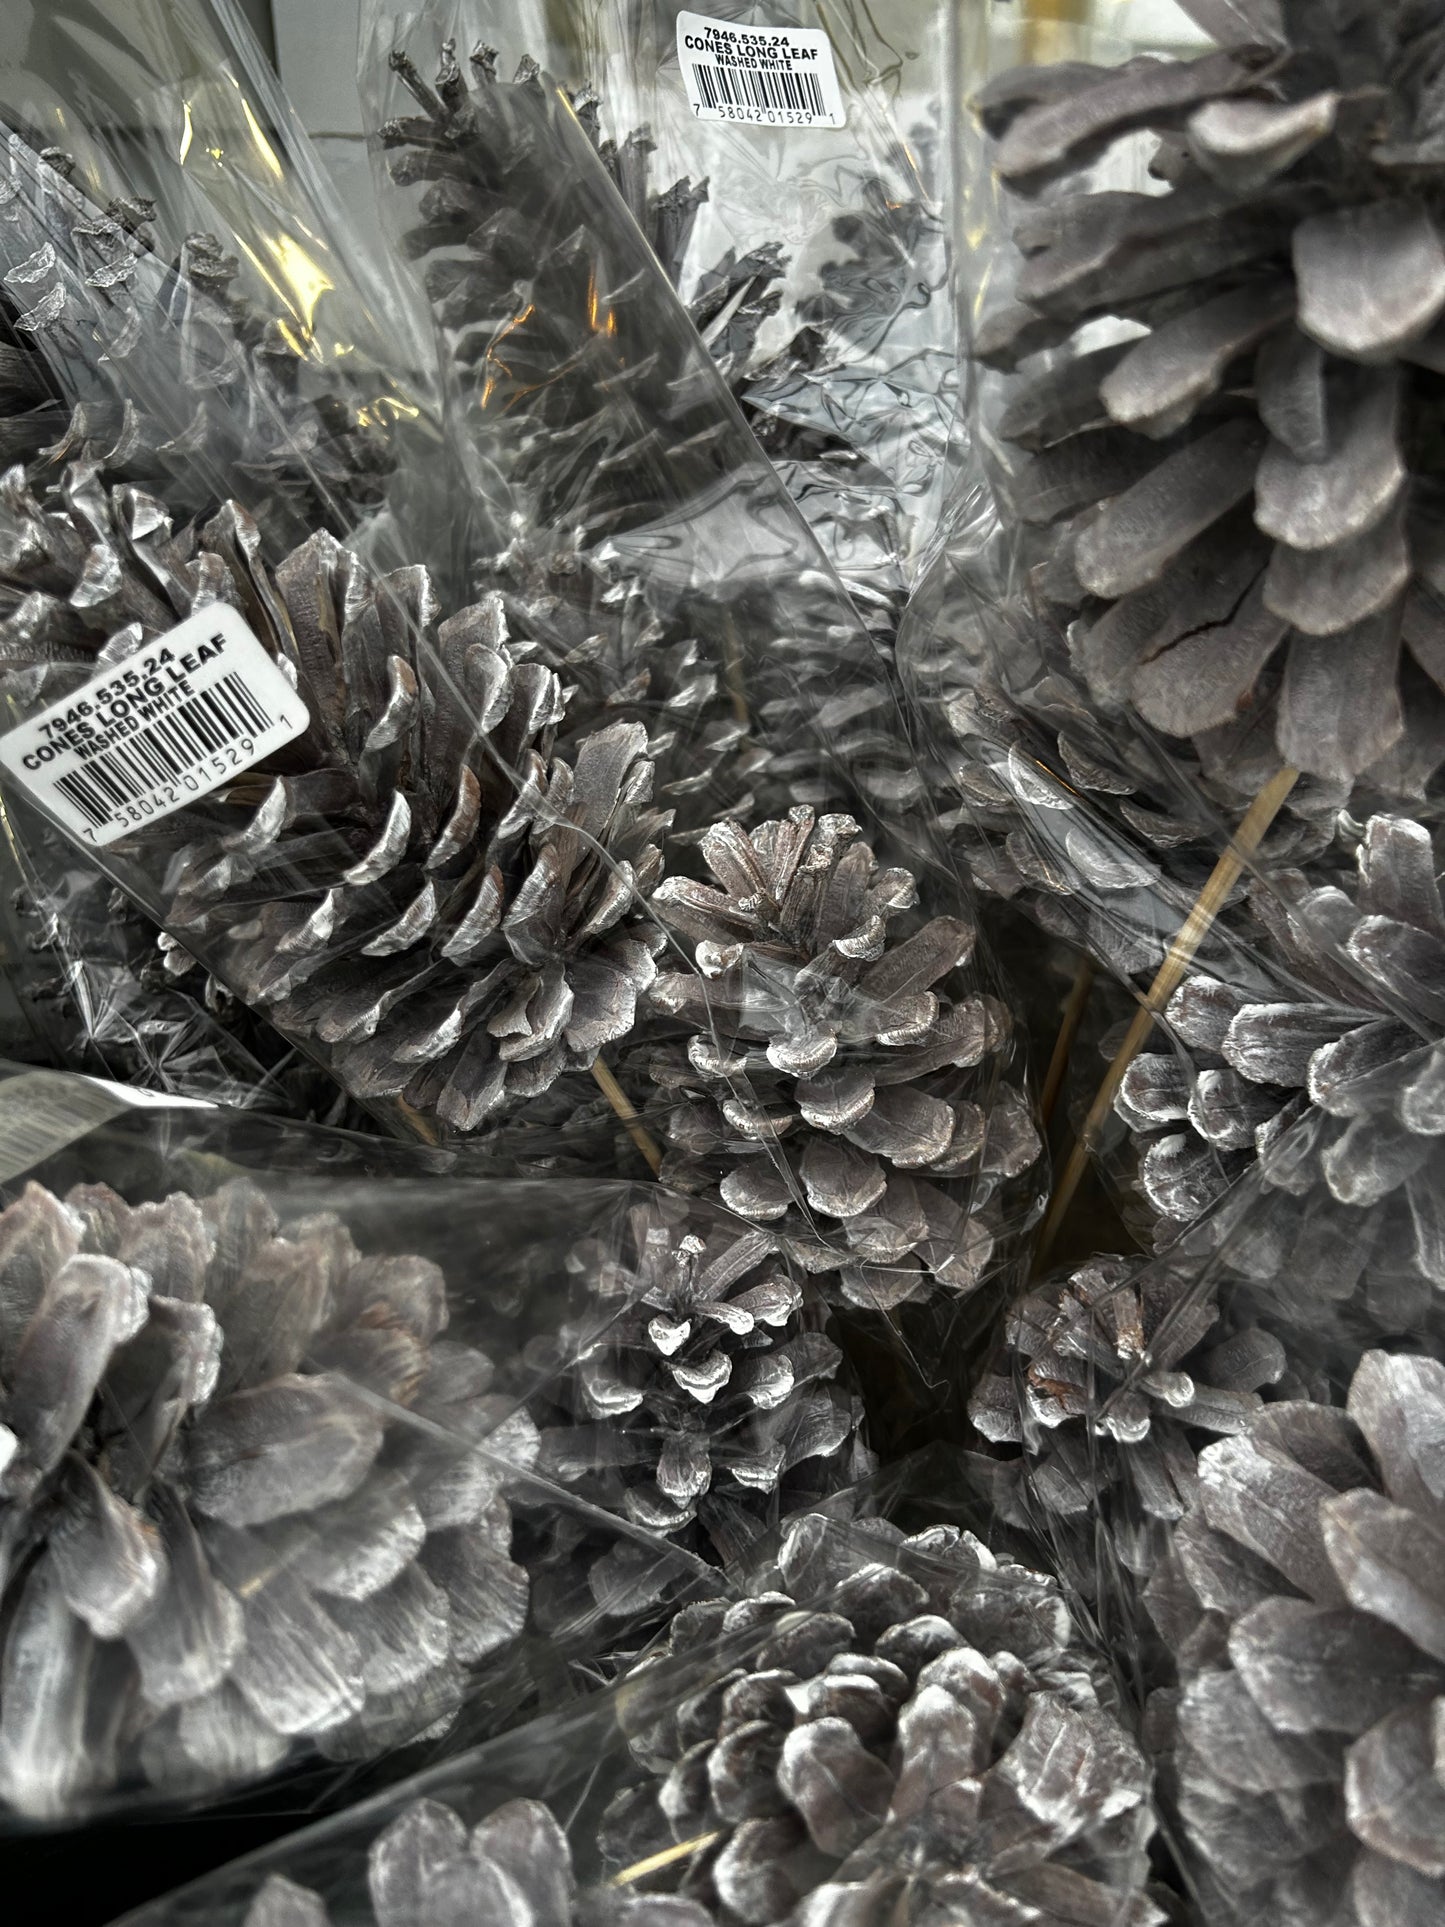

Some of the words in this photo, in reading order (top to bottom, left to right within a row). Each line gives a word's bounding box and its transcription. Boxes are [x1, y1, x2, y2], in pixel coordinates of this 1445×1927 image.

[685, 35, 732, 55] CONES
[736, 45, 778, 59] LONG
[782, 48, 818, 60] LEAF
[704, 27, 790, 47] 7946.535.24
[715, 54, 757, 69] WASHED
[759, 59, 792, 71] WHITE
[22, 721, 96, 770] CONES
[97, 677, 166, 727] LONG
[166, 633, 227, 682] LEAF
[38, 648, 175, 739] 7946.535.24
[74, 715, 140, 761] WASHED
[137, 680, 195, 721] WHITE
